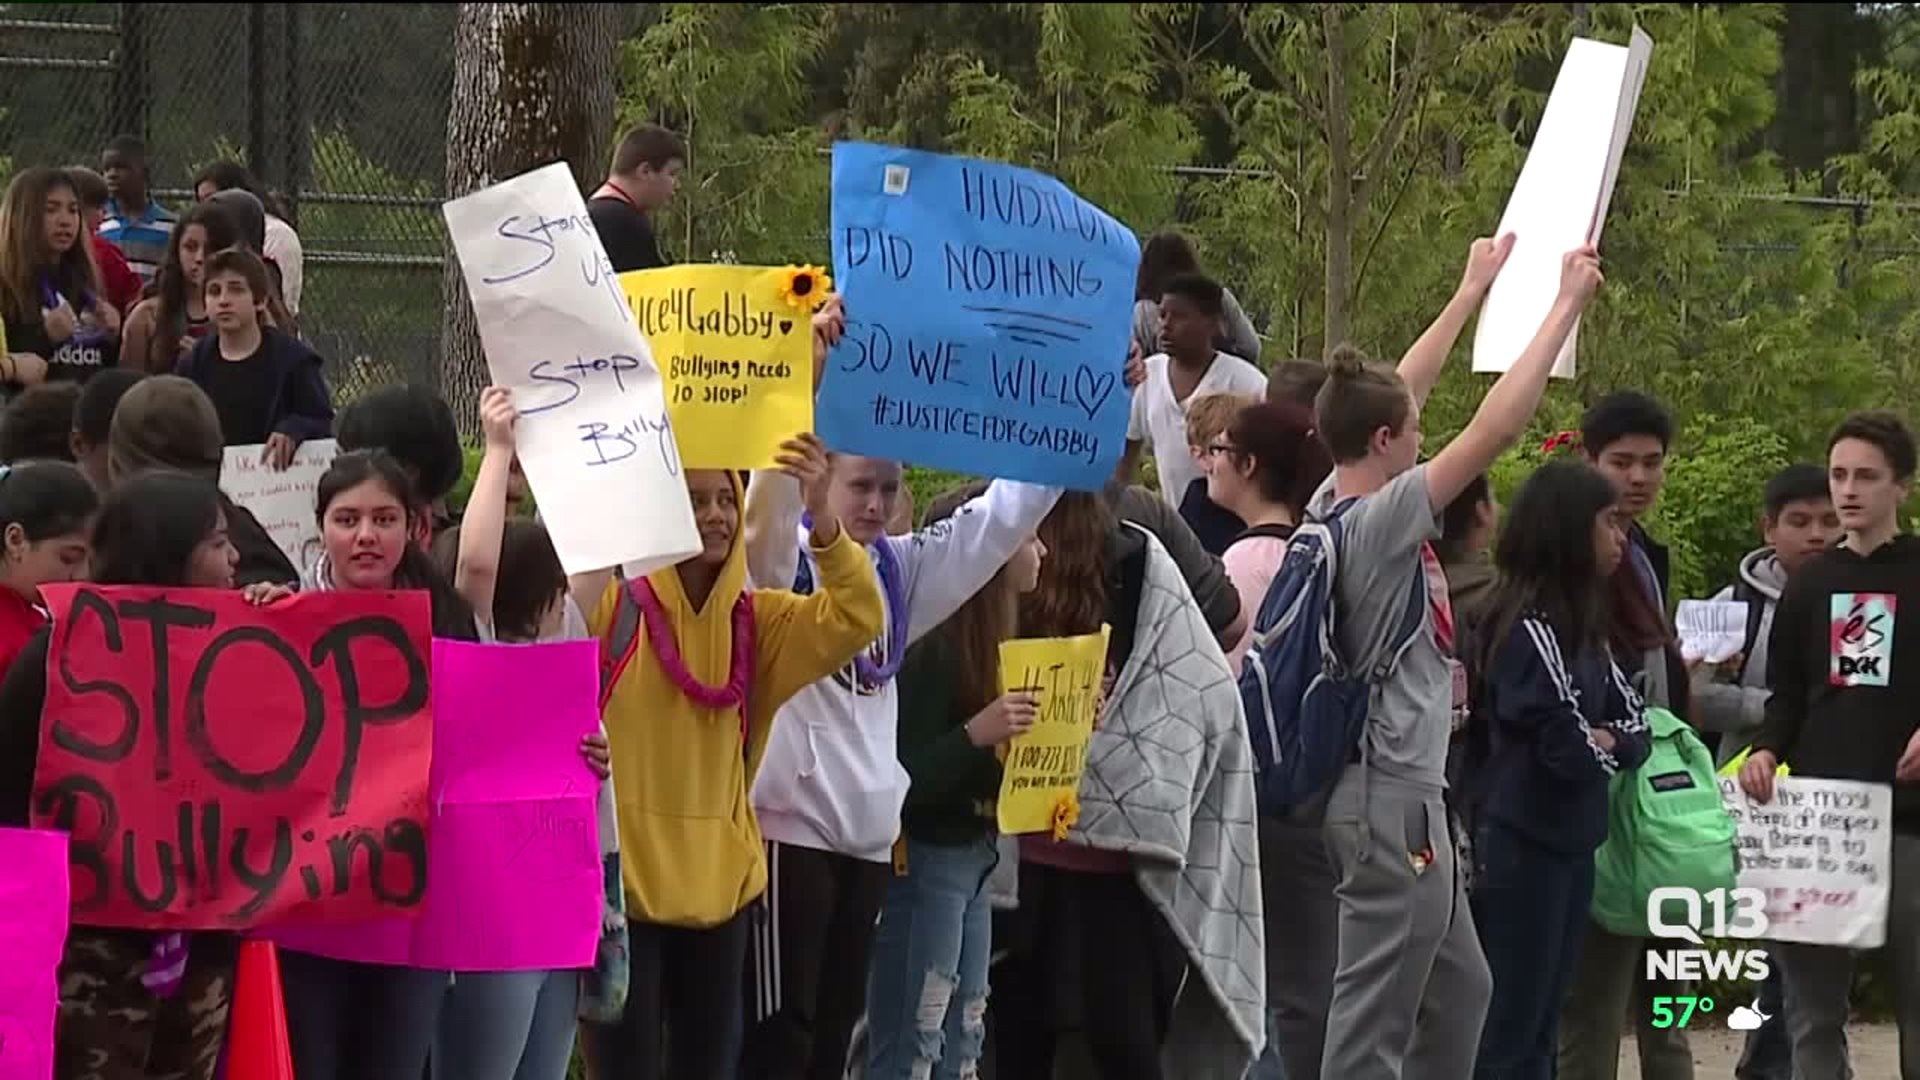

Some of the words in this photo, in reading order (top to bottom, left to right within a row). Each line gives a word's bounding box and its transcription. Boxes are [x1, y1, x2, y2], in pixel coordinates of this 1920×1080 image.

[846, 227, 913, 281] DID
[944, 243, 1102, 299] NOTHING
[519, 354, 640, 415] Stop
[840, 320, 893, 373] SO
[907, 337, 969, 387] WE
[870, 394, 1099, 465] #JUSTICEFORGABBY
[51, 587, 432, 818] STOP
[37, 774, 429, 922] Bullying
